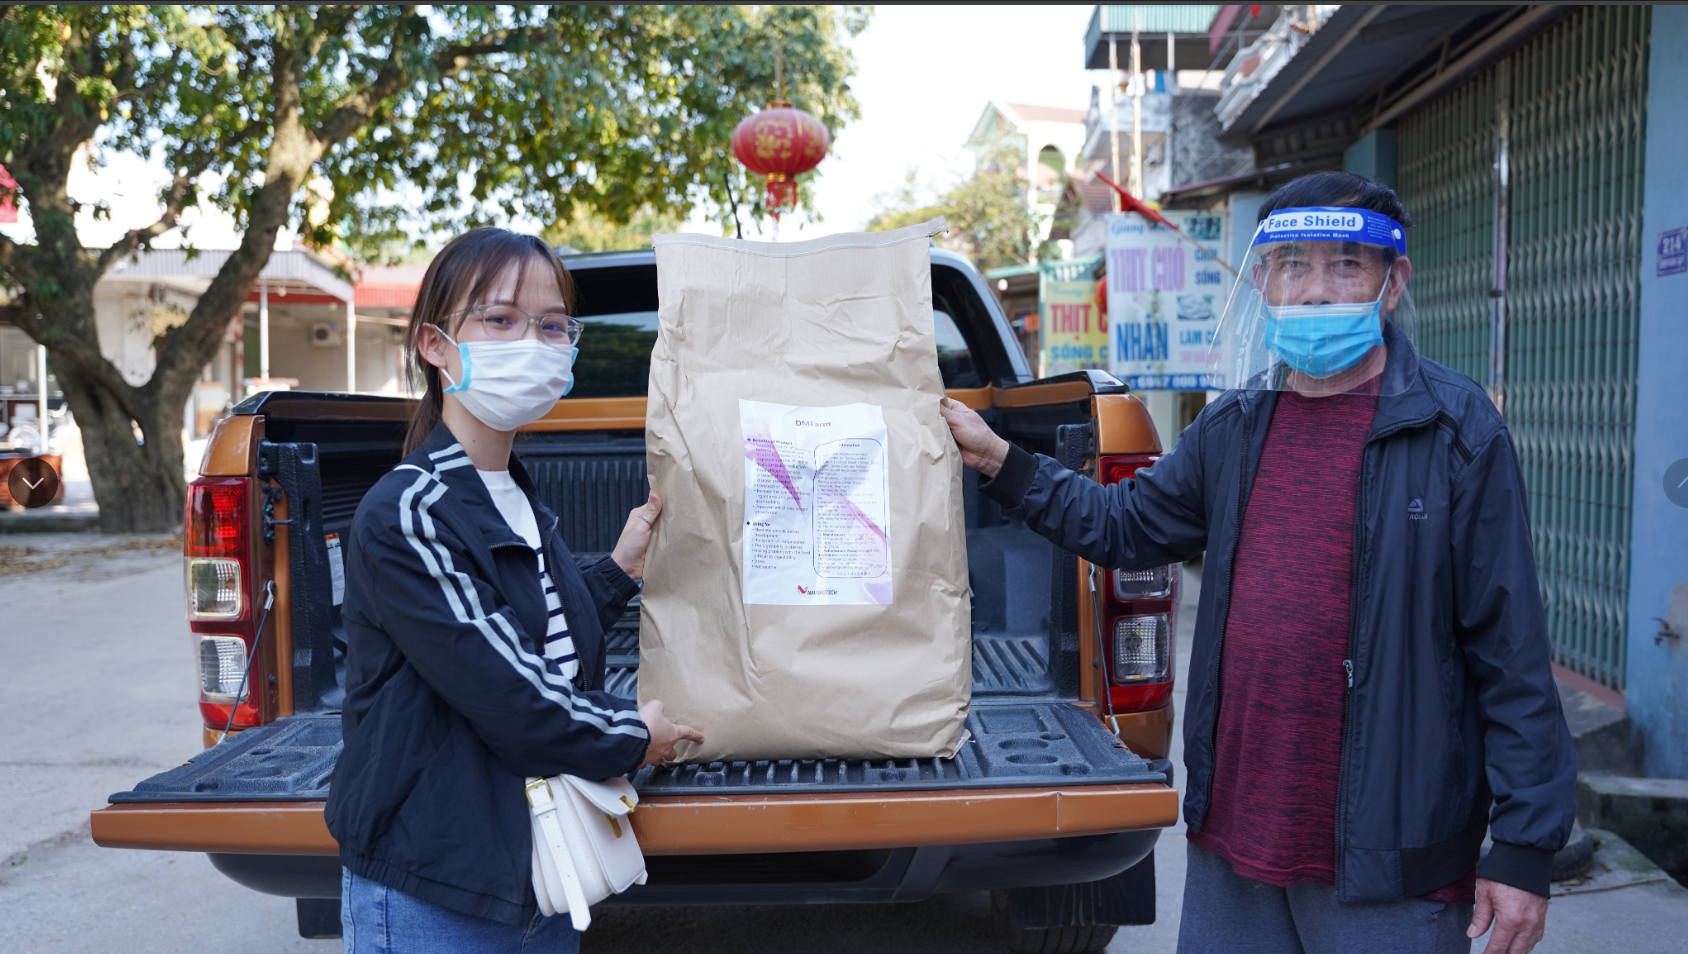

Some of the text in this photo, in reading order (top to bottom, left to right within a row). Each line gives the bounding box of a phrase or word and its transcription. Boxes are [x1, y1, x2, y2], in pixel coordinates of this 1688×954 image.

[1268, 215, 1356, 229] Face Shield
[1050, 303, 1092, 341] THỊT
[795, 419, 832, 428] DMFarm
